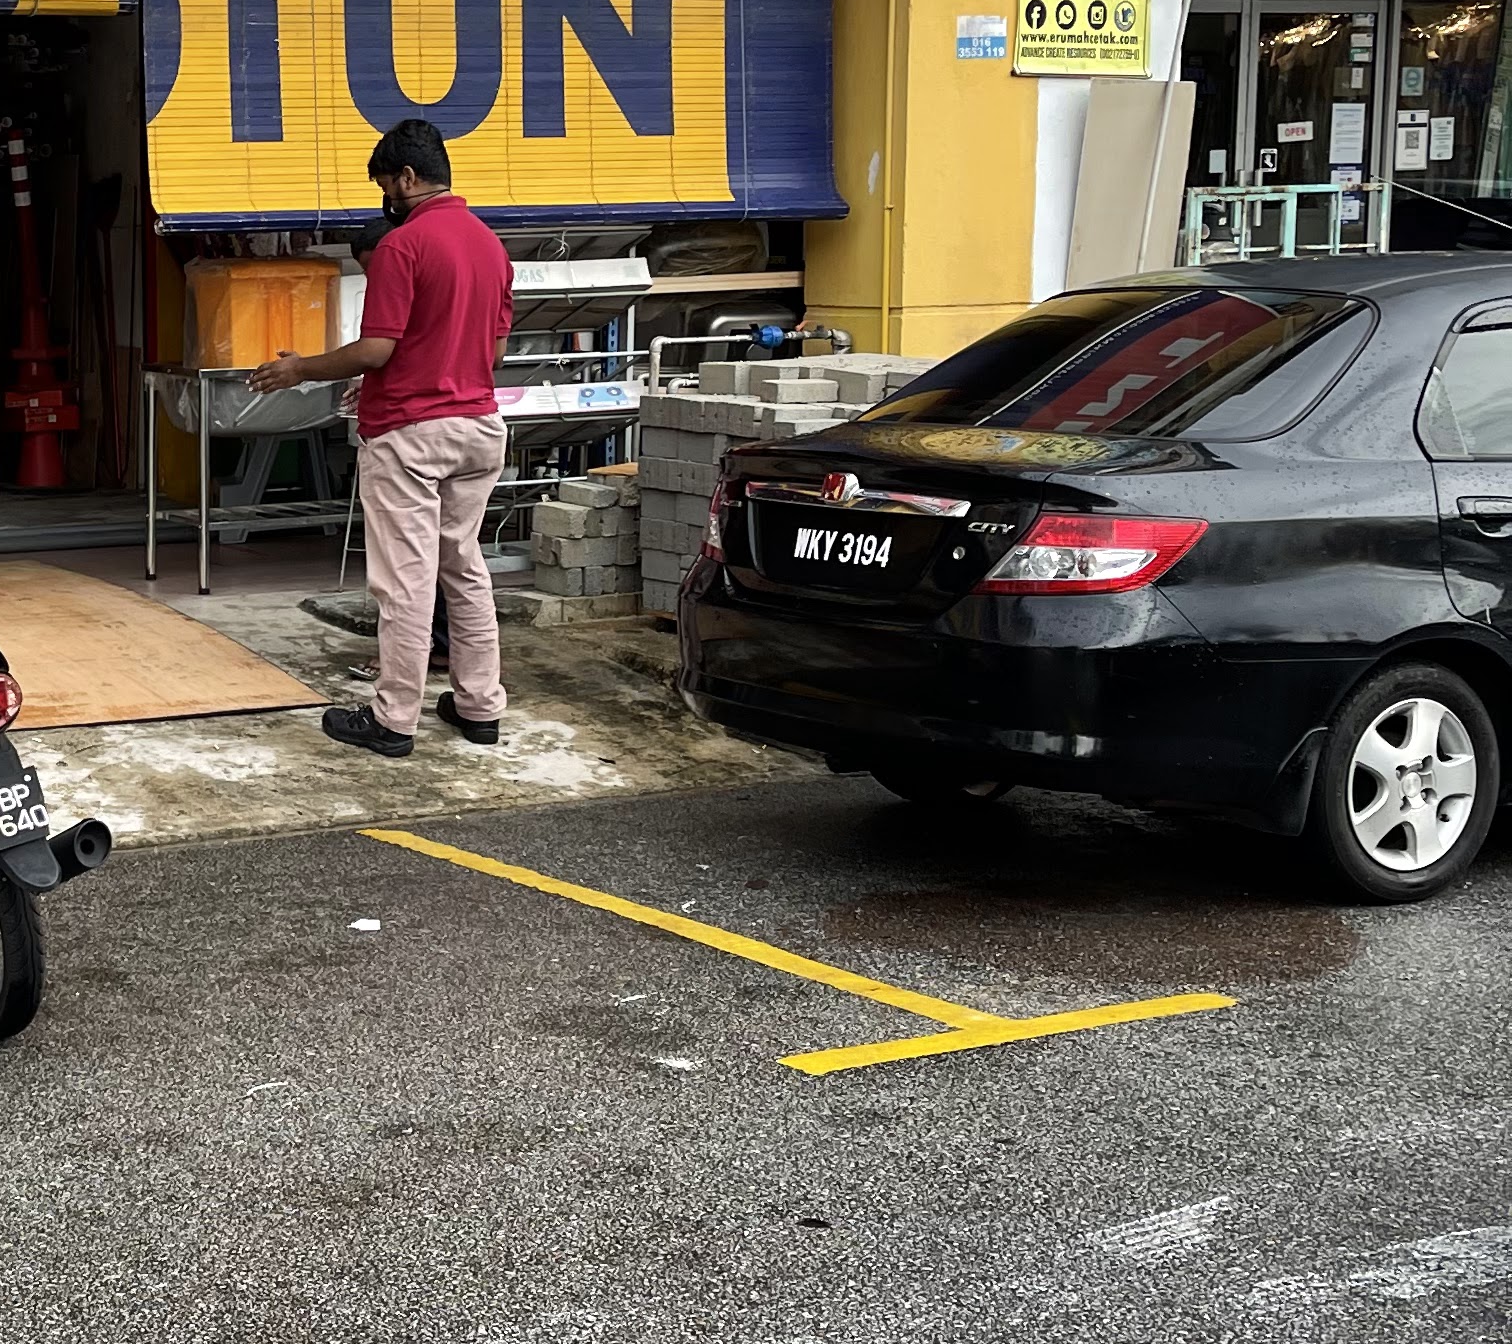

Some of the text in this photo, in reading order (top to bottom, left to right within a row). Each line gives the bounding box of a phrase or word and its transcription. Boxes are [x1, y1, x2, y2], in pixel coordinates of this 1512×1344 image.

[972, 37, 991, 47] 016
[1021, 31, 1138, 44] www.erumahcetak.com
[1285, 128, 1306, 136] OPEN
[968, 521, 1015, 534] CITY
[794, 528, 892, 568] WKY 3194
